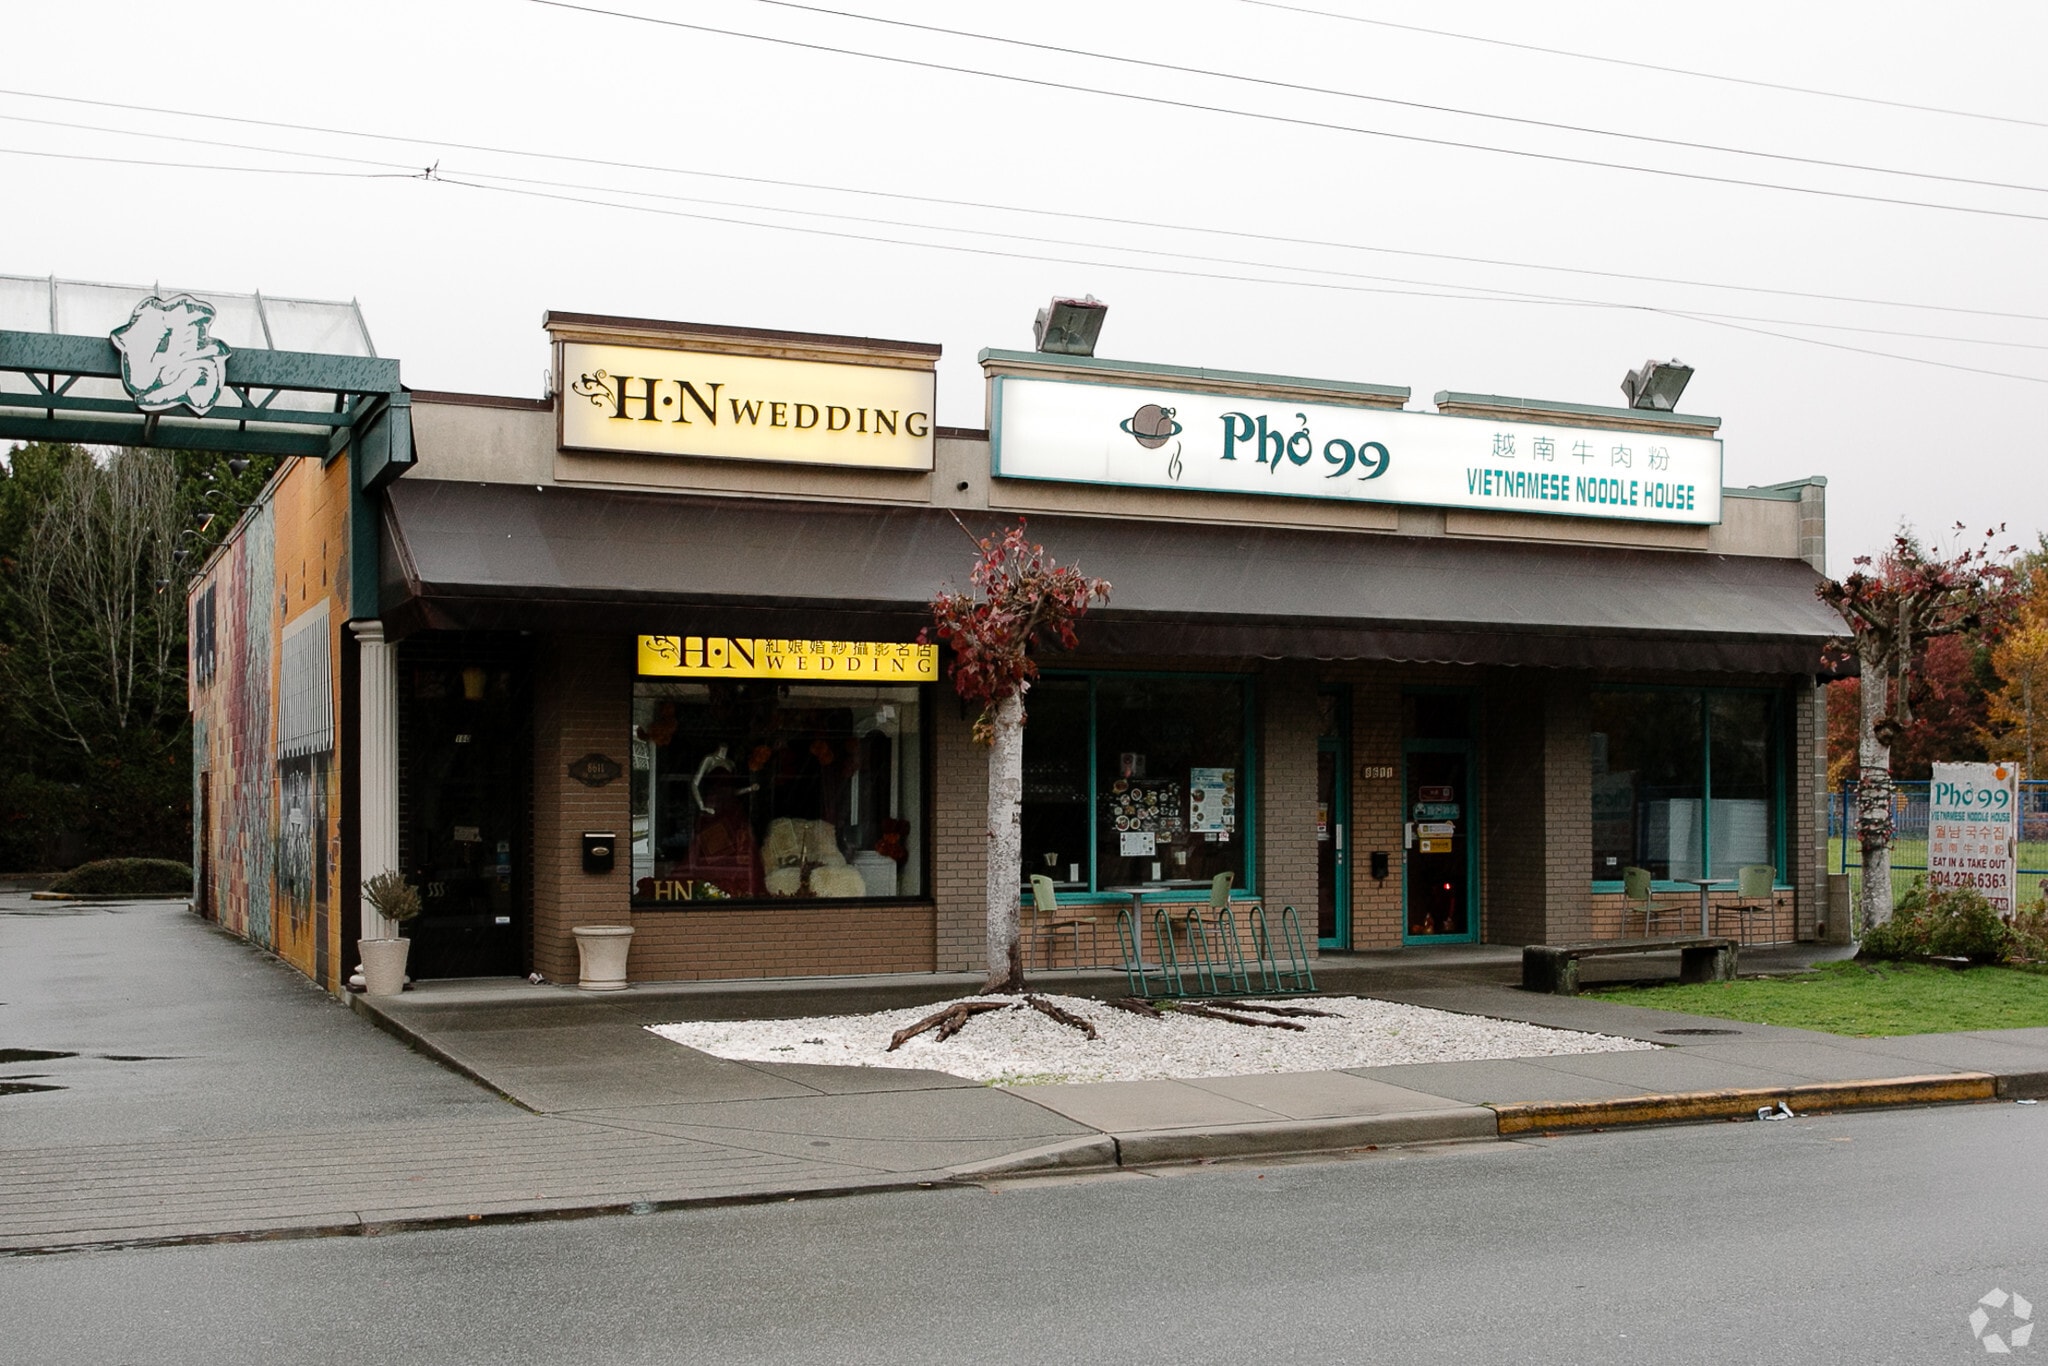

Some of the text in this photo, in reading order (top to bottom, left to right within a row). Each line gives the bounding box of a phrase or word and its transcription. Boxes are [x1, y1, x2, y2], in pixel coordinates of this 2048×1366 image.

[729, 398, 929, 438] WEDDING
[1323, 438, 1390, 481] 99
[1491, 432, 1670, 472] 越南牛肉粉
[1466, 467, 1695, 511] VIETNAMESE NOODLE HOUSE
[766, 655, 931, 673] WEDDING
[1977, 788, 2009, 810] 99
[1931, 811, 1966, 821] VIETNAMESE
[1990, 812, 2010, 823] HOUSE
[1933, 857, 2006, 870] EAT IN & TAKE OUT
[653, 879, 694, 901] HN
